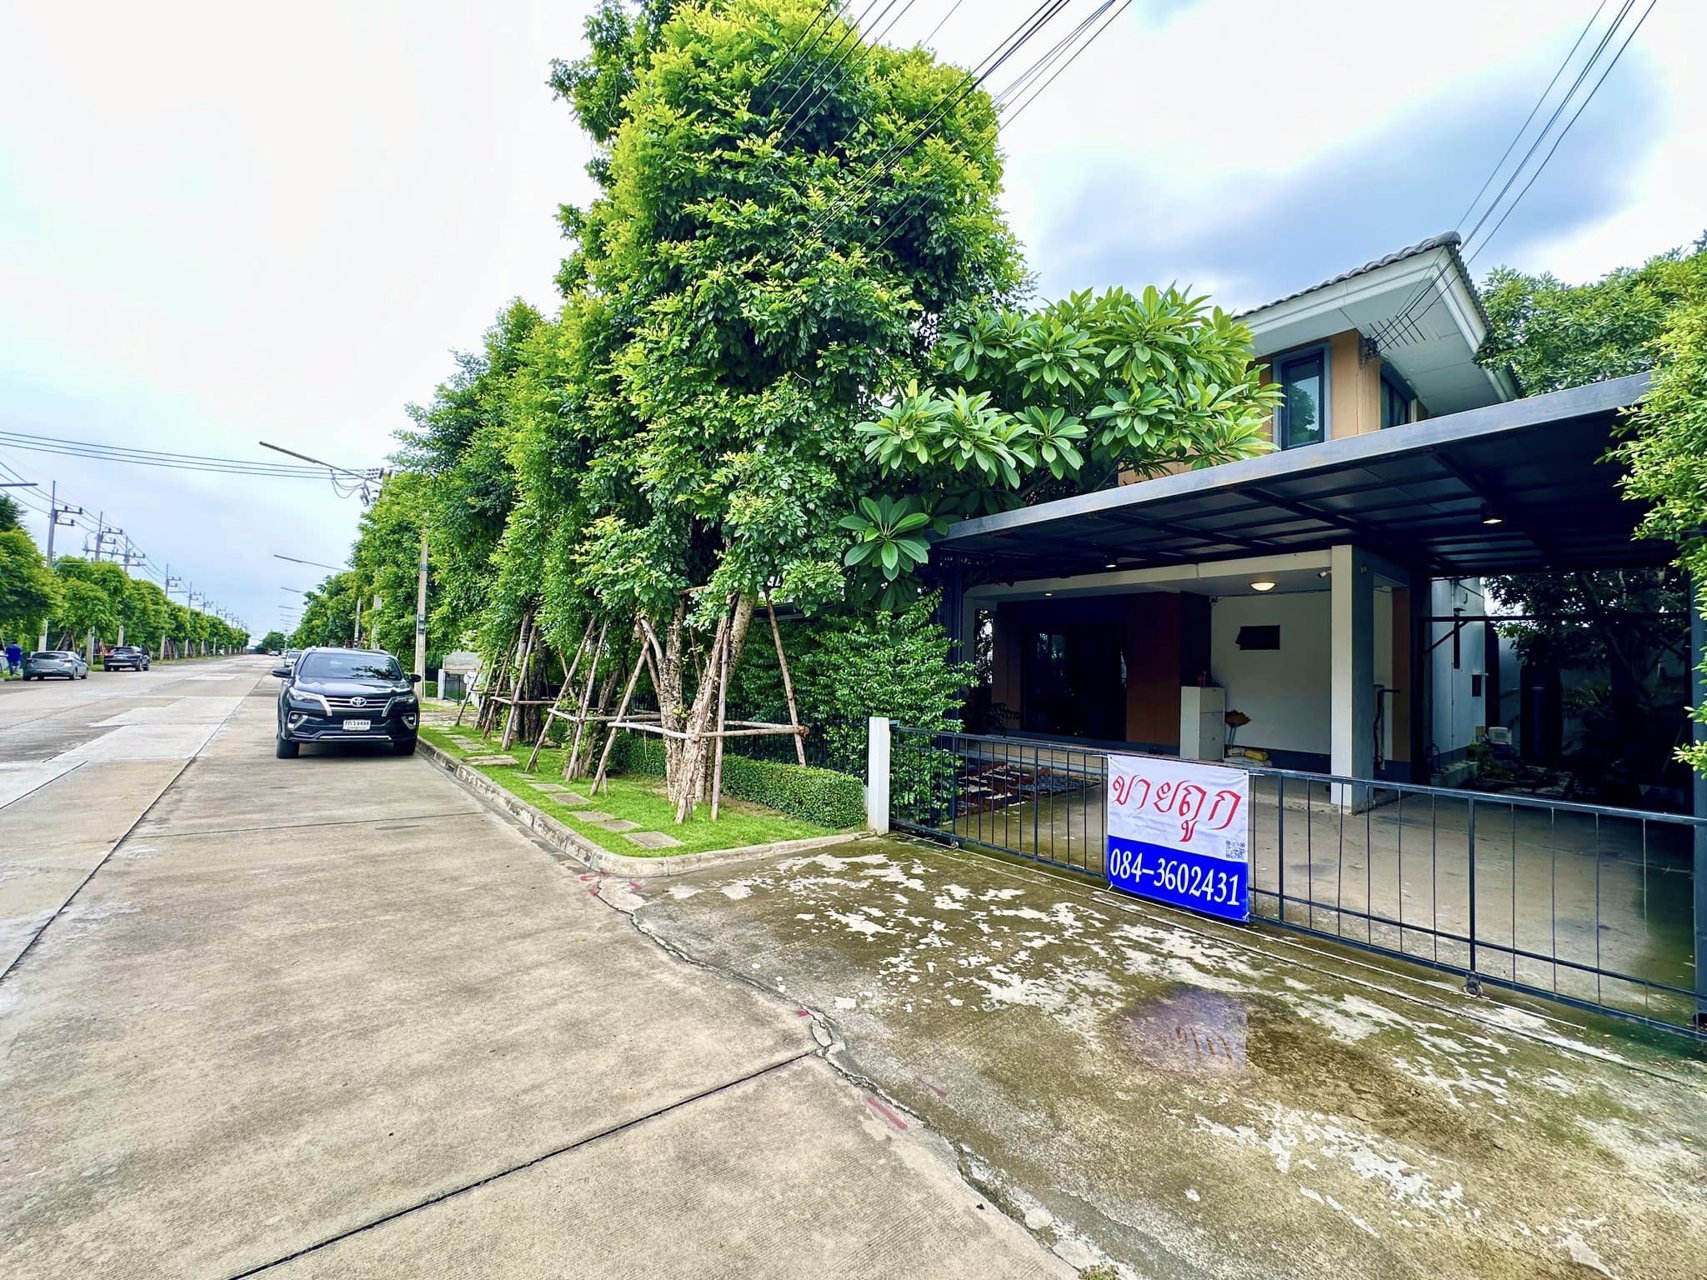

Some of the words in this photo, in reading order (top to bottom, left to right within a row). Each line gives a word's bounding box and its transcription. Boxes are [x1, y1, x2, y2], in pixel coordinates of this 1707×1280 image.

[1112, 775, 1242, 843] ขายถูก
[1110, 848, 1240, 906] 084-3602431
